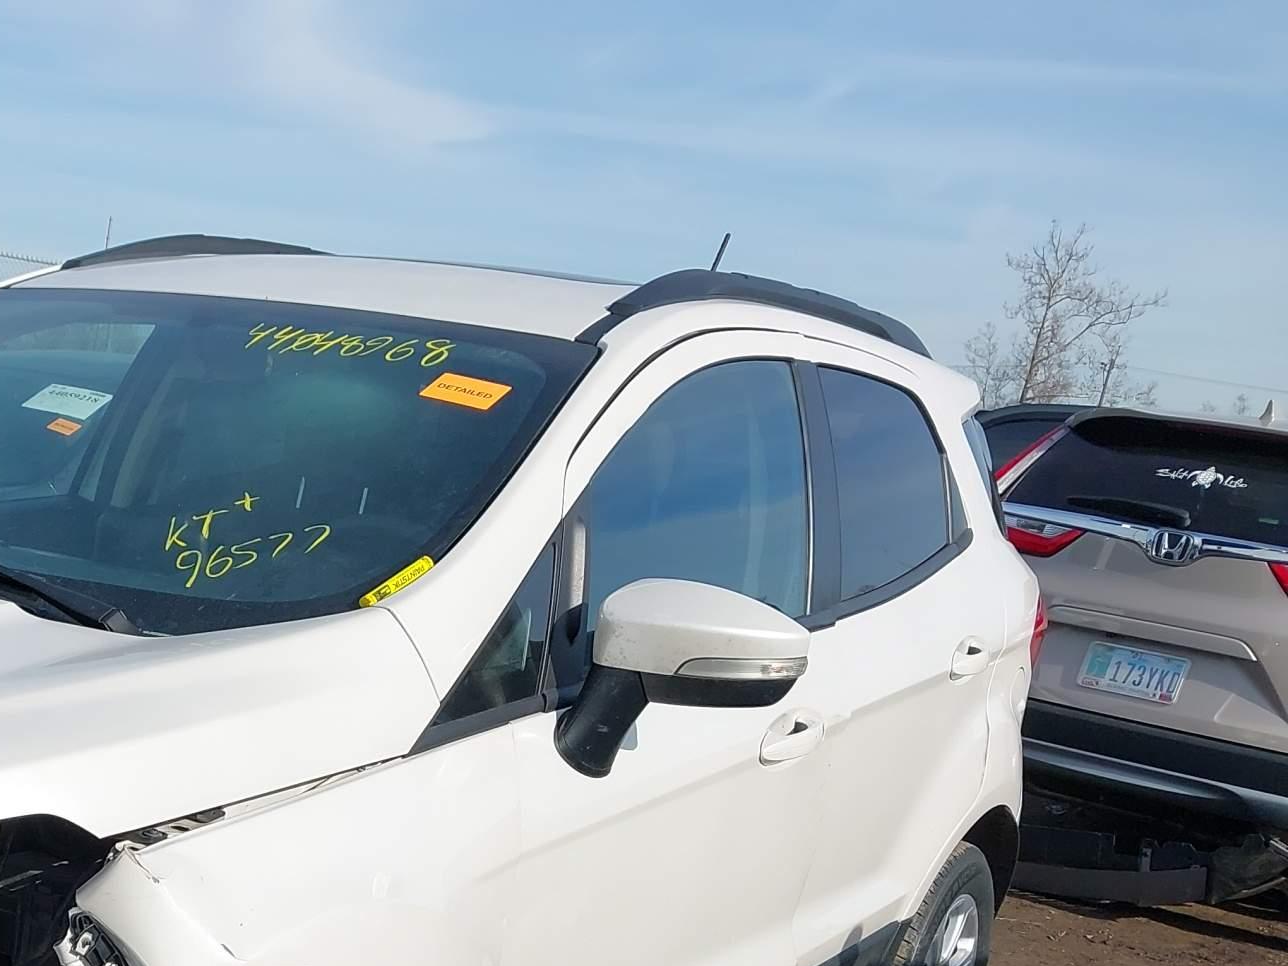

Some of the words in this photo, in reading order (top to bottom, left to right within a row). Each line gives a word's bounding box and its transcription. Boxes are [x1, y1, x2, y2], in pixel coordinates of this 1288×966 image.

[245, 322, 456, 367] 44048968
[436, 382, 493, 401] DETAILED
[176, 524, 331, 588] 96577
